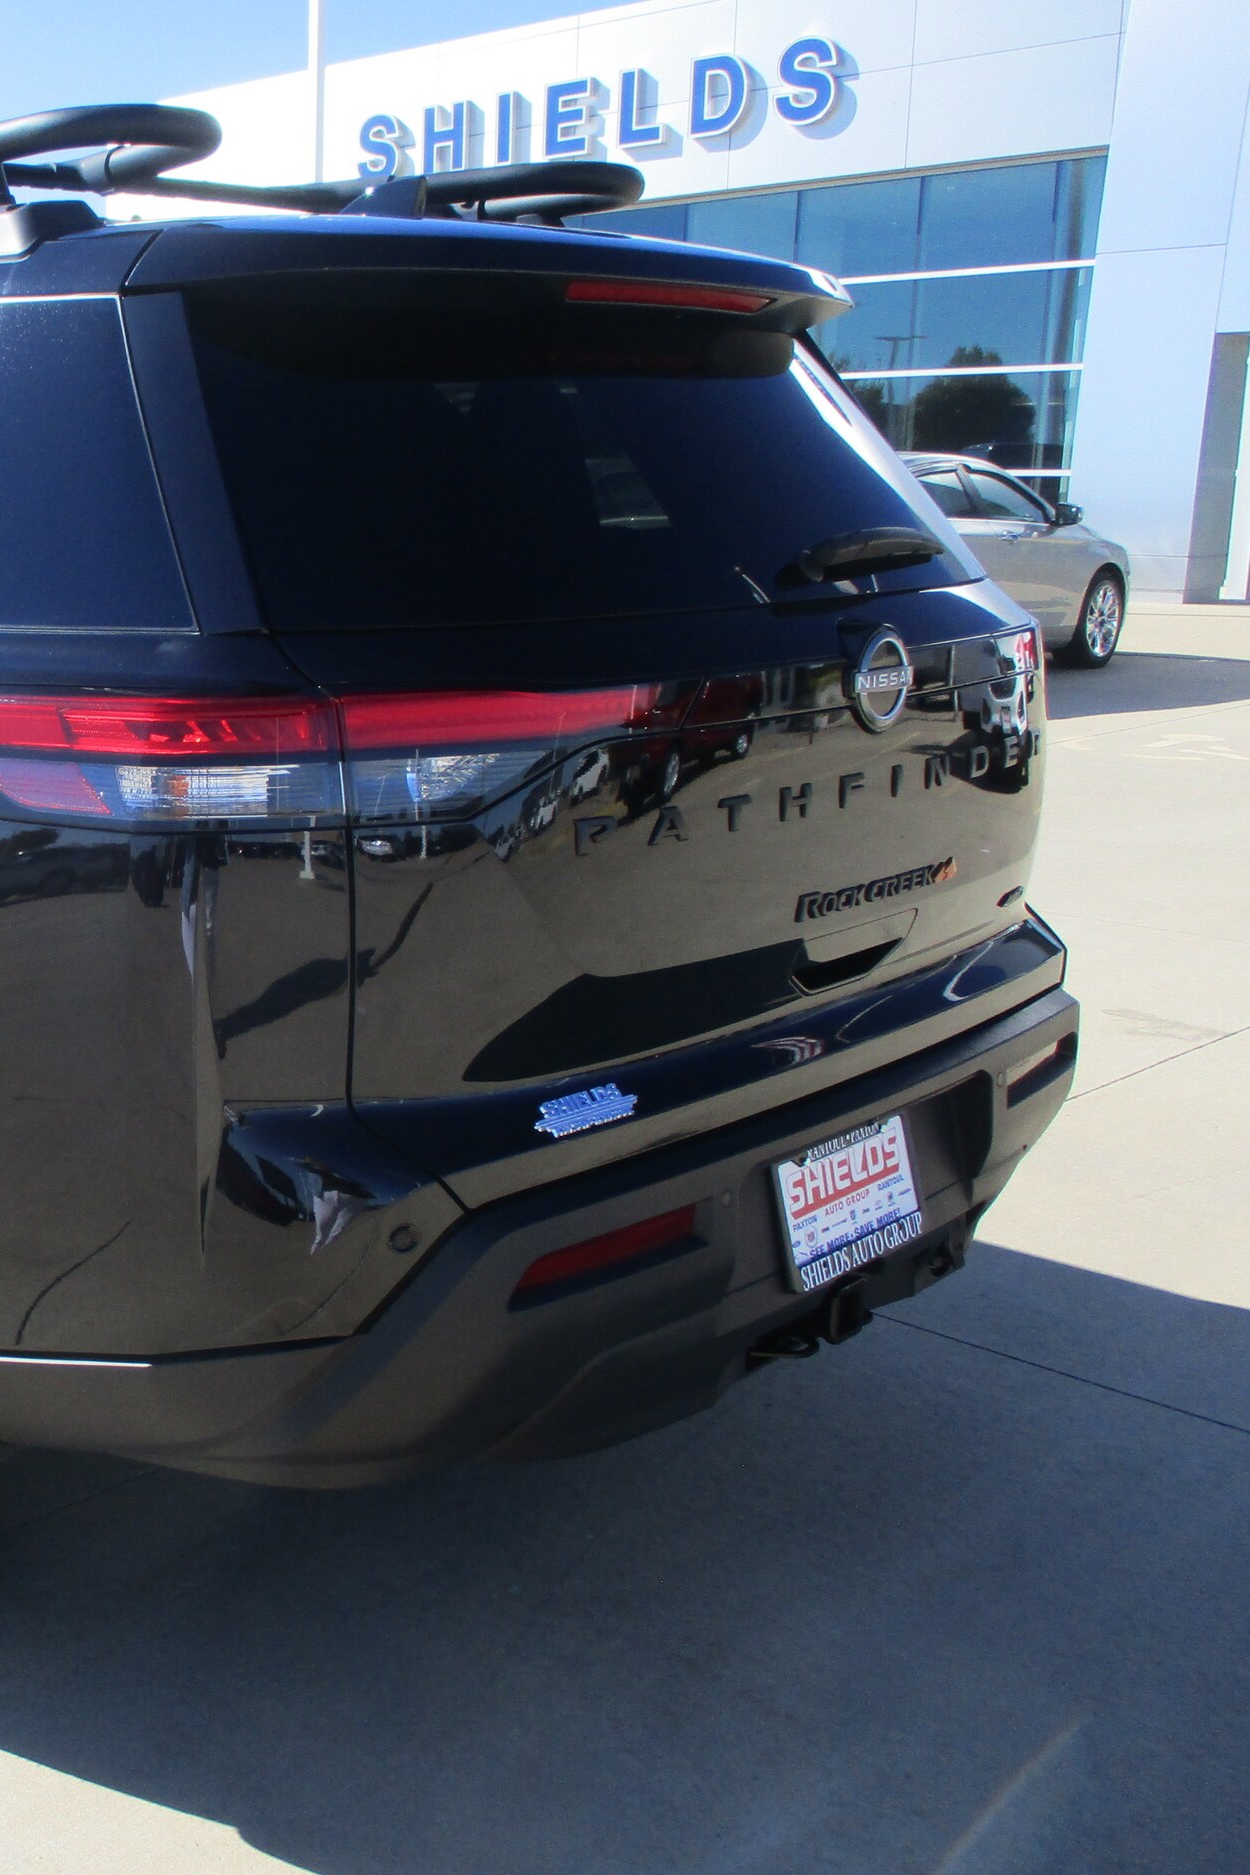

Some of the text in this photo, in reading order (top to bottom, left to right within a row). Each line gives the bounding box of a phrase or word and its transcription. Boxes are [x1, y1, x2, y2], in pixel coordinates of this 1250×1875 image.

[357, 36, 838, 178] SHIELDS
[574, 728, 1041, 856] PATHFINDER
[794, 863, 937, 923] ROCK CREEK
[539, 1083, 622, 1119] SHIELDS
[786, 1126, 900, 1214] SHIELDS
[792, 1215, 818, 1232] PAXTON
[825, 1202, 844, 1217] AUTO
[846, 1189, 870, 1206] GROUP
[800, 1211, 922, 1292] SHIELDS AUTO GROUP
[810, 1244, 825, 1258] SEE
[827, 1232, 851, 1252] MORE
[854, 1221, 875, 1238] SAVE
